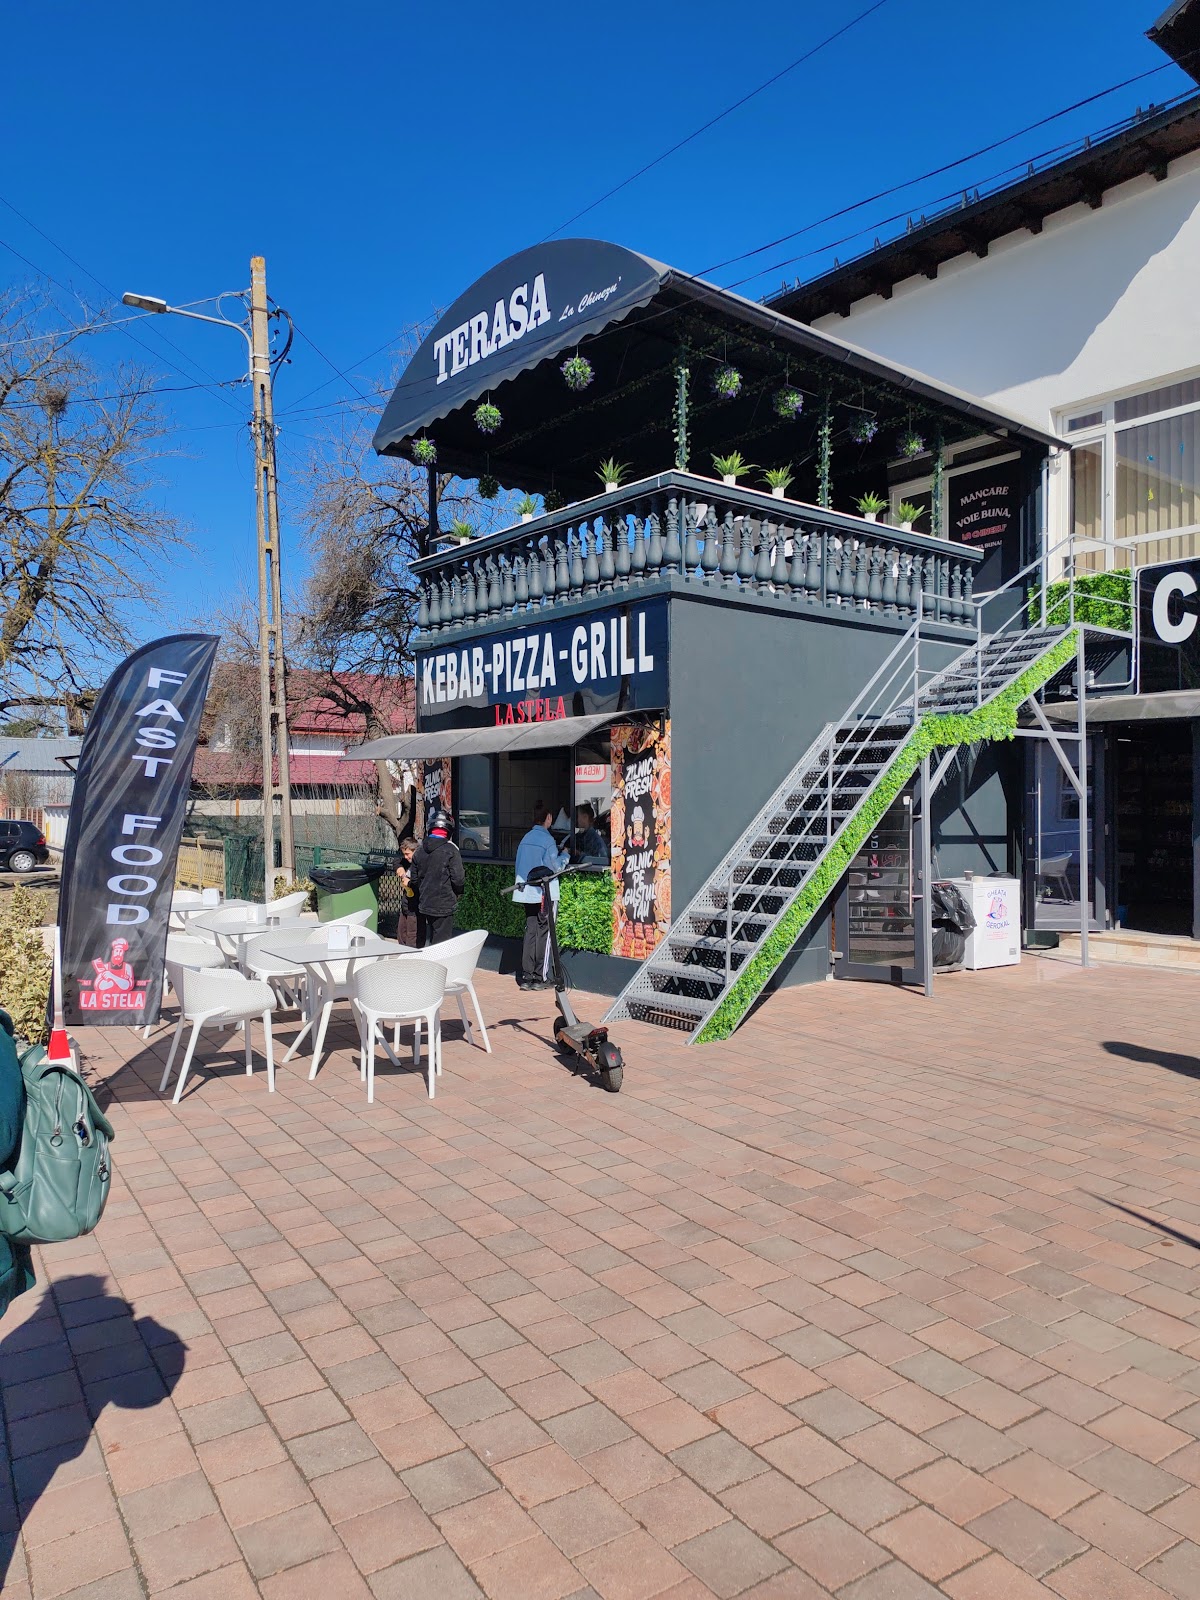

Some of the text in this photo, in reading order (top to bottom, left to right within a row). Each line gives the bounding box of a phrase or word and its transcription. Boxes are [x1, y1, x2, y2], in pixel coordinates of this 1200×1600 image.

[558, 304, 574, 322] La
[433, 272, 551, 386] TERASA
[960, 486, 1009, 507] MANCARE
[956, 508, 1011, 528] VOIE BUNA,
[1152, 571, 1198, 644] C
[625, 756, 653, 782] ZILNIC
[105, 667, 187, 926] FAST FOOD
[625, 774, 653, 802] FRESH
[625, 849, 653, 873] ZILNIC
[632, 870, 646, 889] PE
[80, 992, 144, 1008] LA STELA
